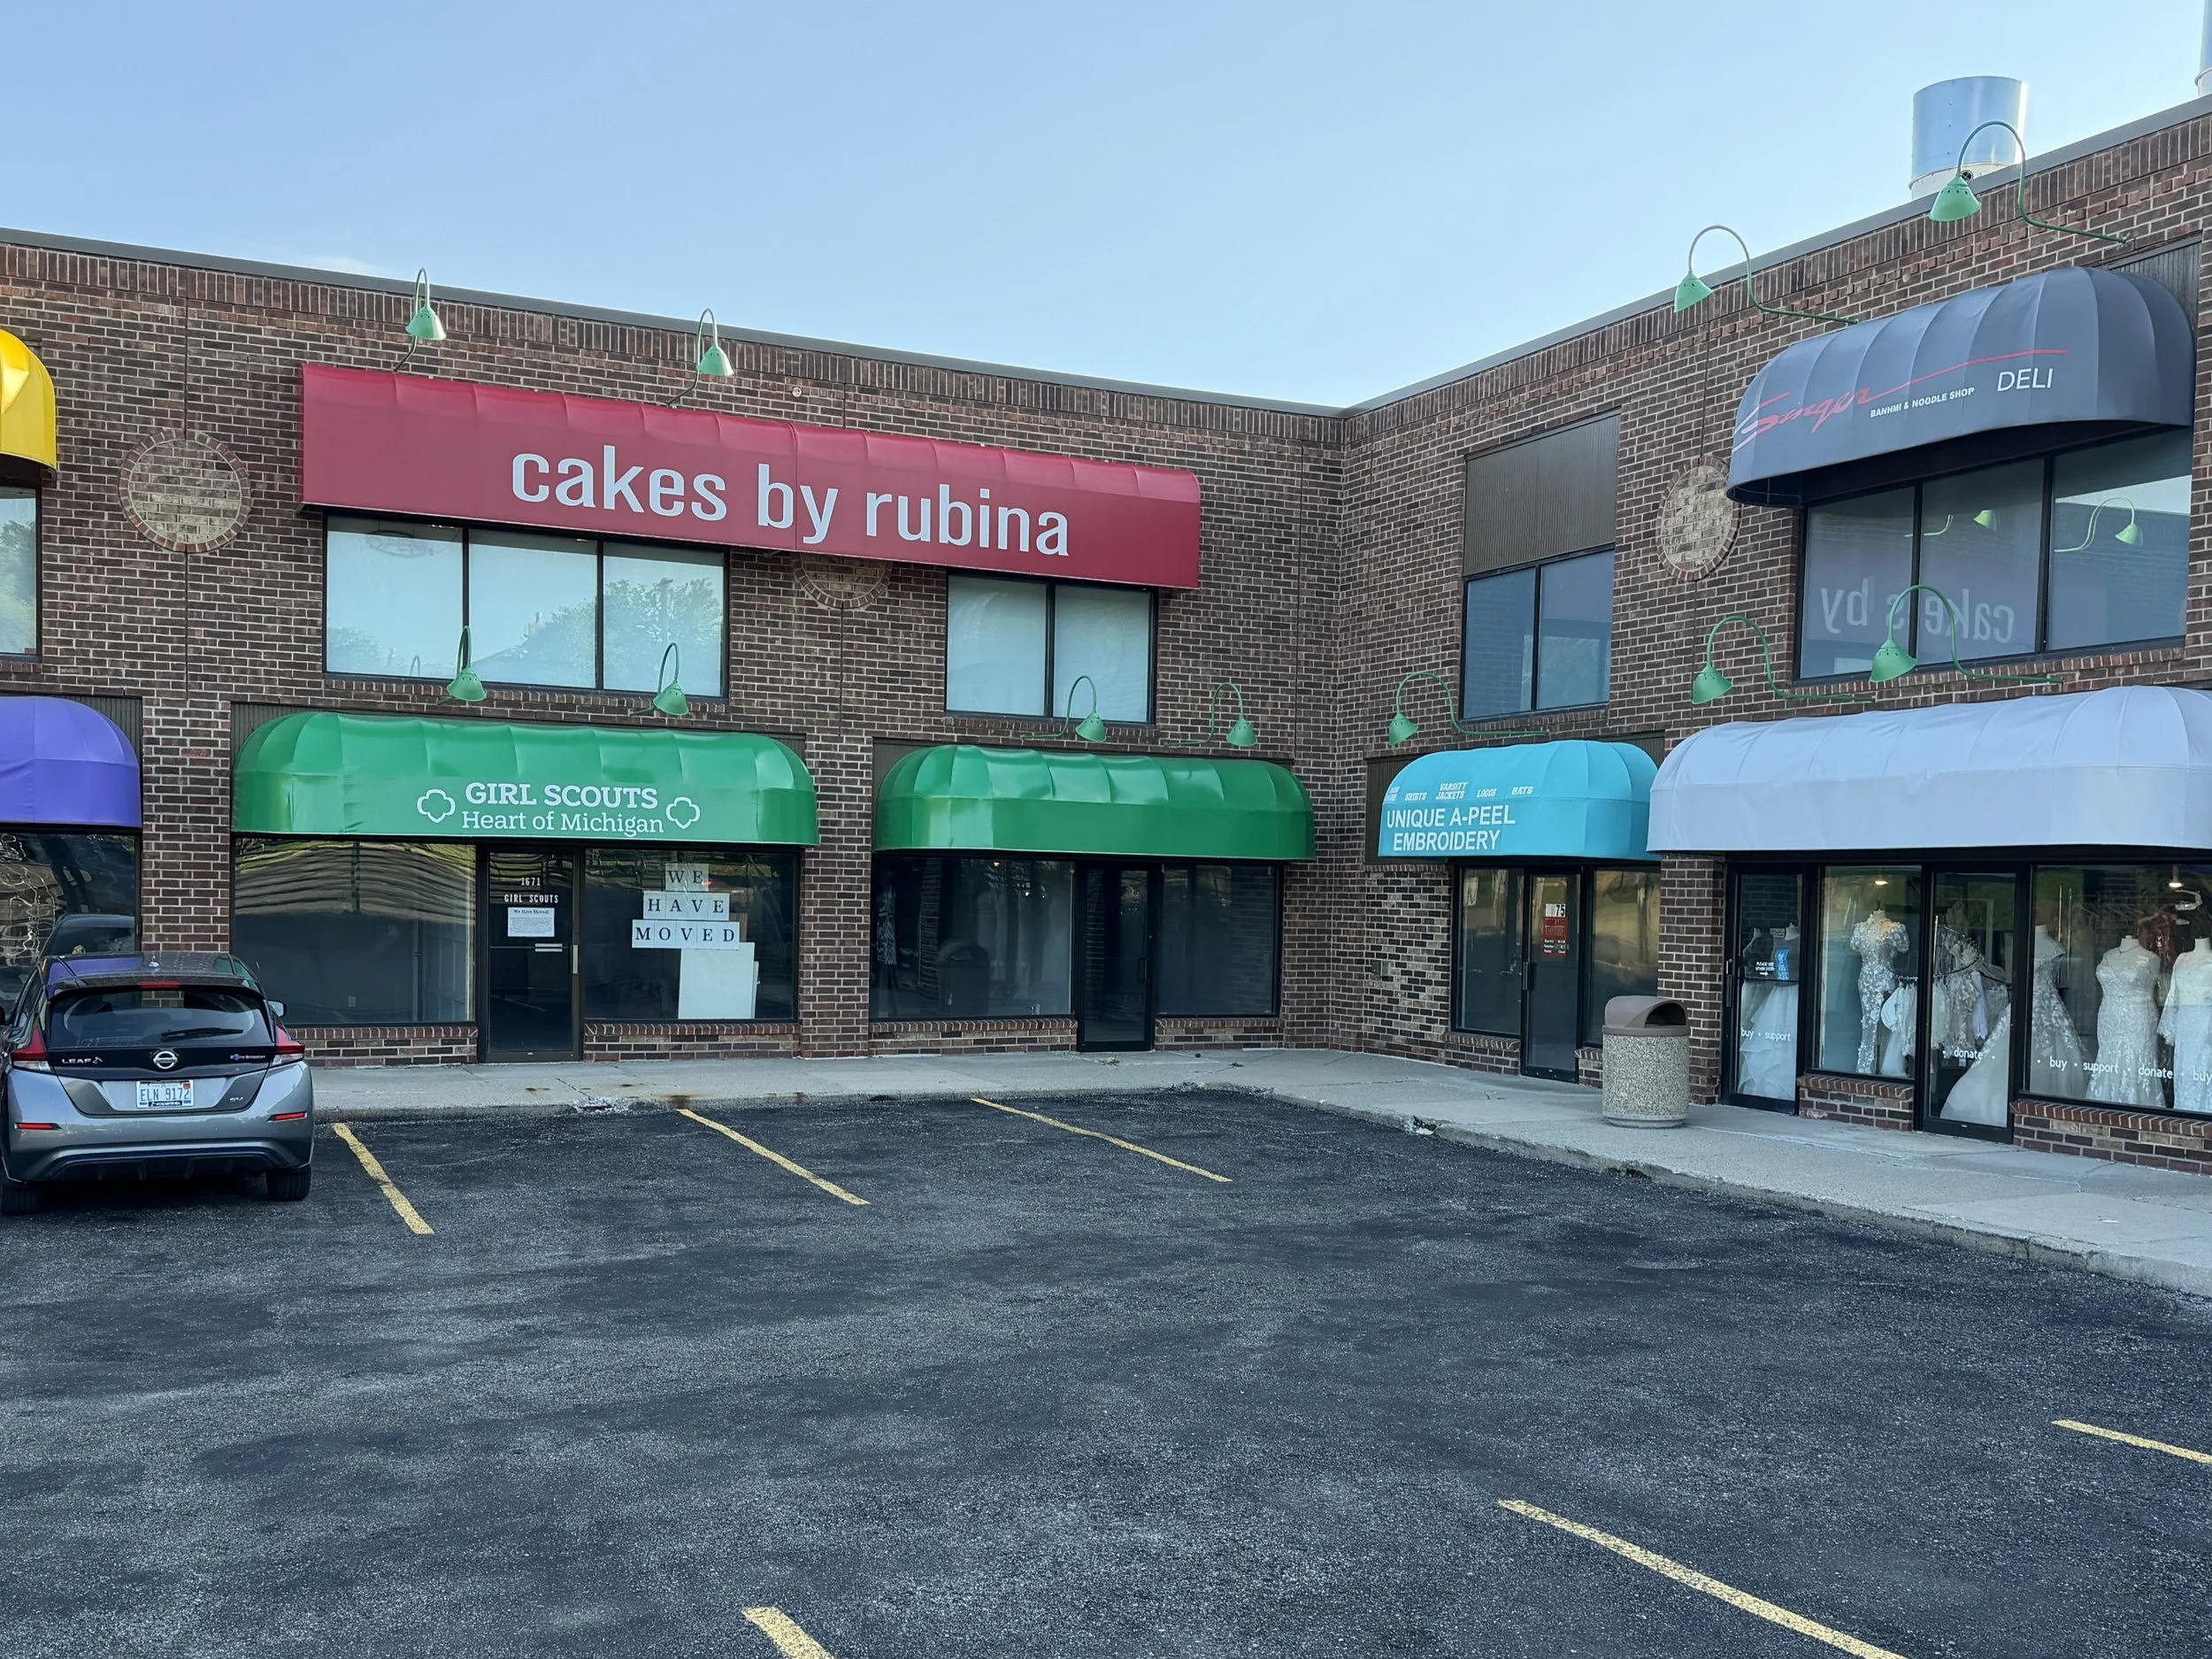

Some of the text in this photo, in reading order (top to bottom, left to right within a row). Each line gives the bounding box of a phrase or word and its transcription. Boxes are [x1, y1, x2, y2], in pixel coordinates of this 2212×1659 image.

[1996, 367, 2054, 392] DELI
[1870, 387, 1975, 419] BANHMI & NOODLE SHOP
[511, 444, 1069, 557] cakes by rubina
[465, 781, 658, 809] GIRL SCOUTS
[1511, 786, 1533, 795] HATS
[462, 810, 664, 837] Heart of Michigan
[1386, 804, 1516, 828] UNIQUE A-PEEL
[1393, 829, 1501, 851] EMBROIDERY
[521, 877, 541, 886] 1671
[668, 871, 703, 883] WE
[504, 894, 558, 903] GIRL SCOUTS
[648, 898, 724, 913] HAVE
[635, 926, 734, 942] MOVED
[1740, 1027, 1791, 1041] buy support
[1954, 1047, 1983, 1060] donate
[2049, 1056, 2212, 1086] buy support donate buy
[141, 1087, 191, 1102] ELN 9172
